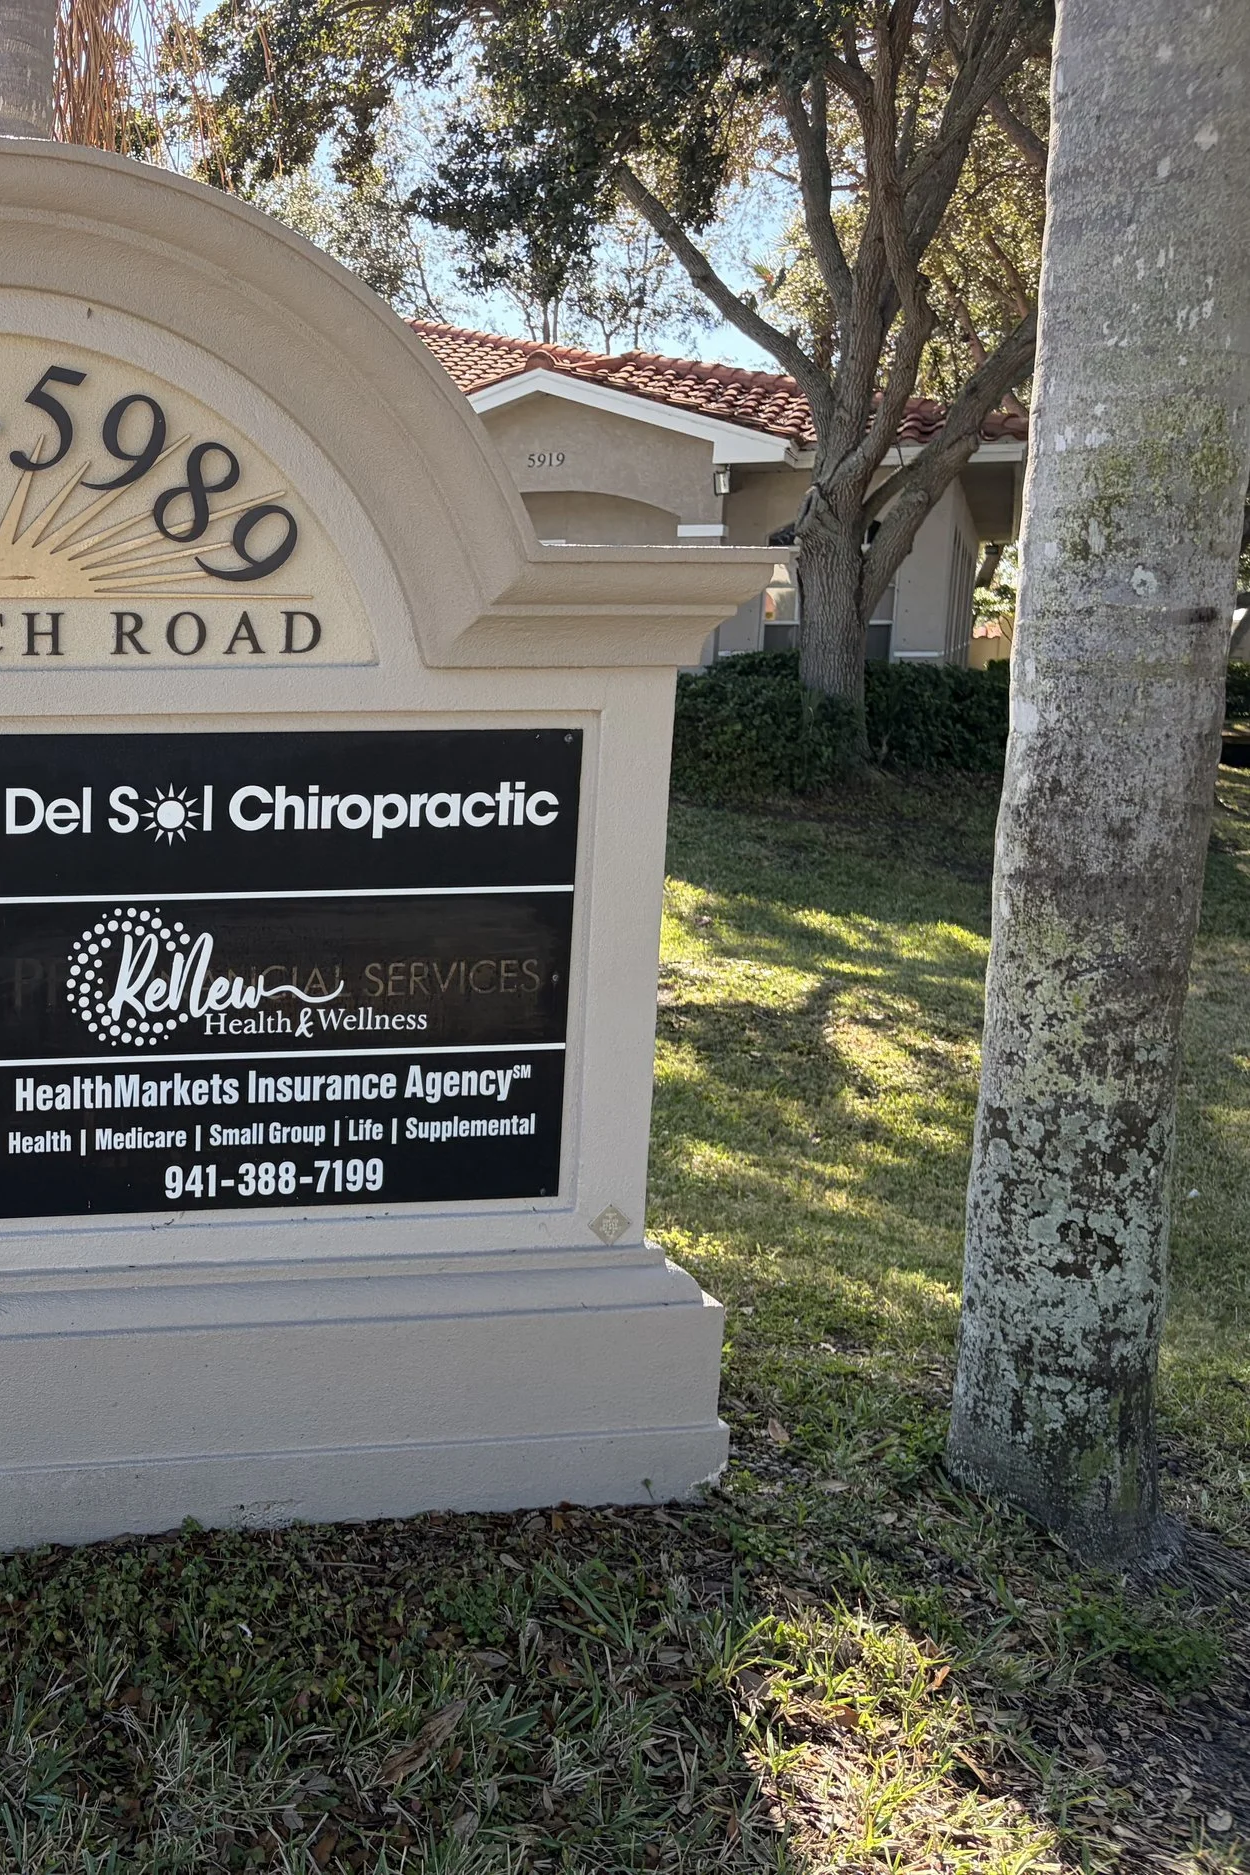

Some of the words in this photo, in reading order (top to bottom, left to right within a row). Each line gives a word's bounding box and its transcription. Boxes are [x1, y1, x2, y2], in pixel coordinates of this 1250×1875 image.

[527, 452, 566, 468] 5919
[111, 612, 321, 655] ROAD
[6, 787, 91, 834] Del
[229, 782, 558, 838] Chiropractic
[363, 958, 542, 998] SERVICES
[204, 1011, 292, 1034] Health
[295, 1006, 314, 1038] &
[317, 1007, 427, 1030] Wellness
[16, 1073, 239, 1111] HealthMarkets
[249, 1071, 396, 1103] Insurance
[9, 1130, 71, 1153] Health
[96, 1127, 186, 1150] Medicare
[210, 1123, 263, 1146] Small
[269, 1122, 325, 1146] Group
[349, 1119, 383, 1140] Life
[406, 1113, 535, 1140] Supplemental
[165, 1158, 383, 1199] 941-388-7199
